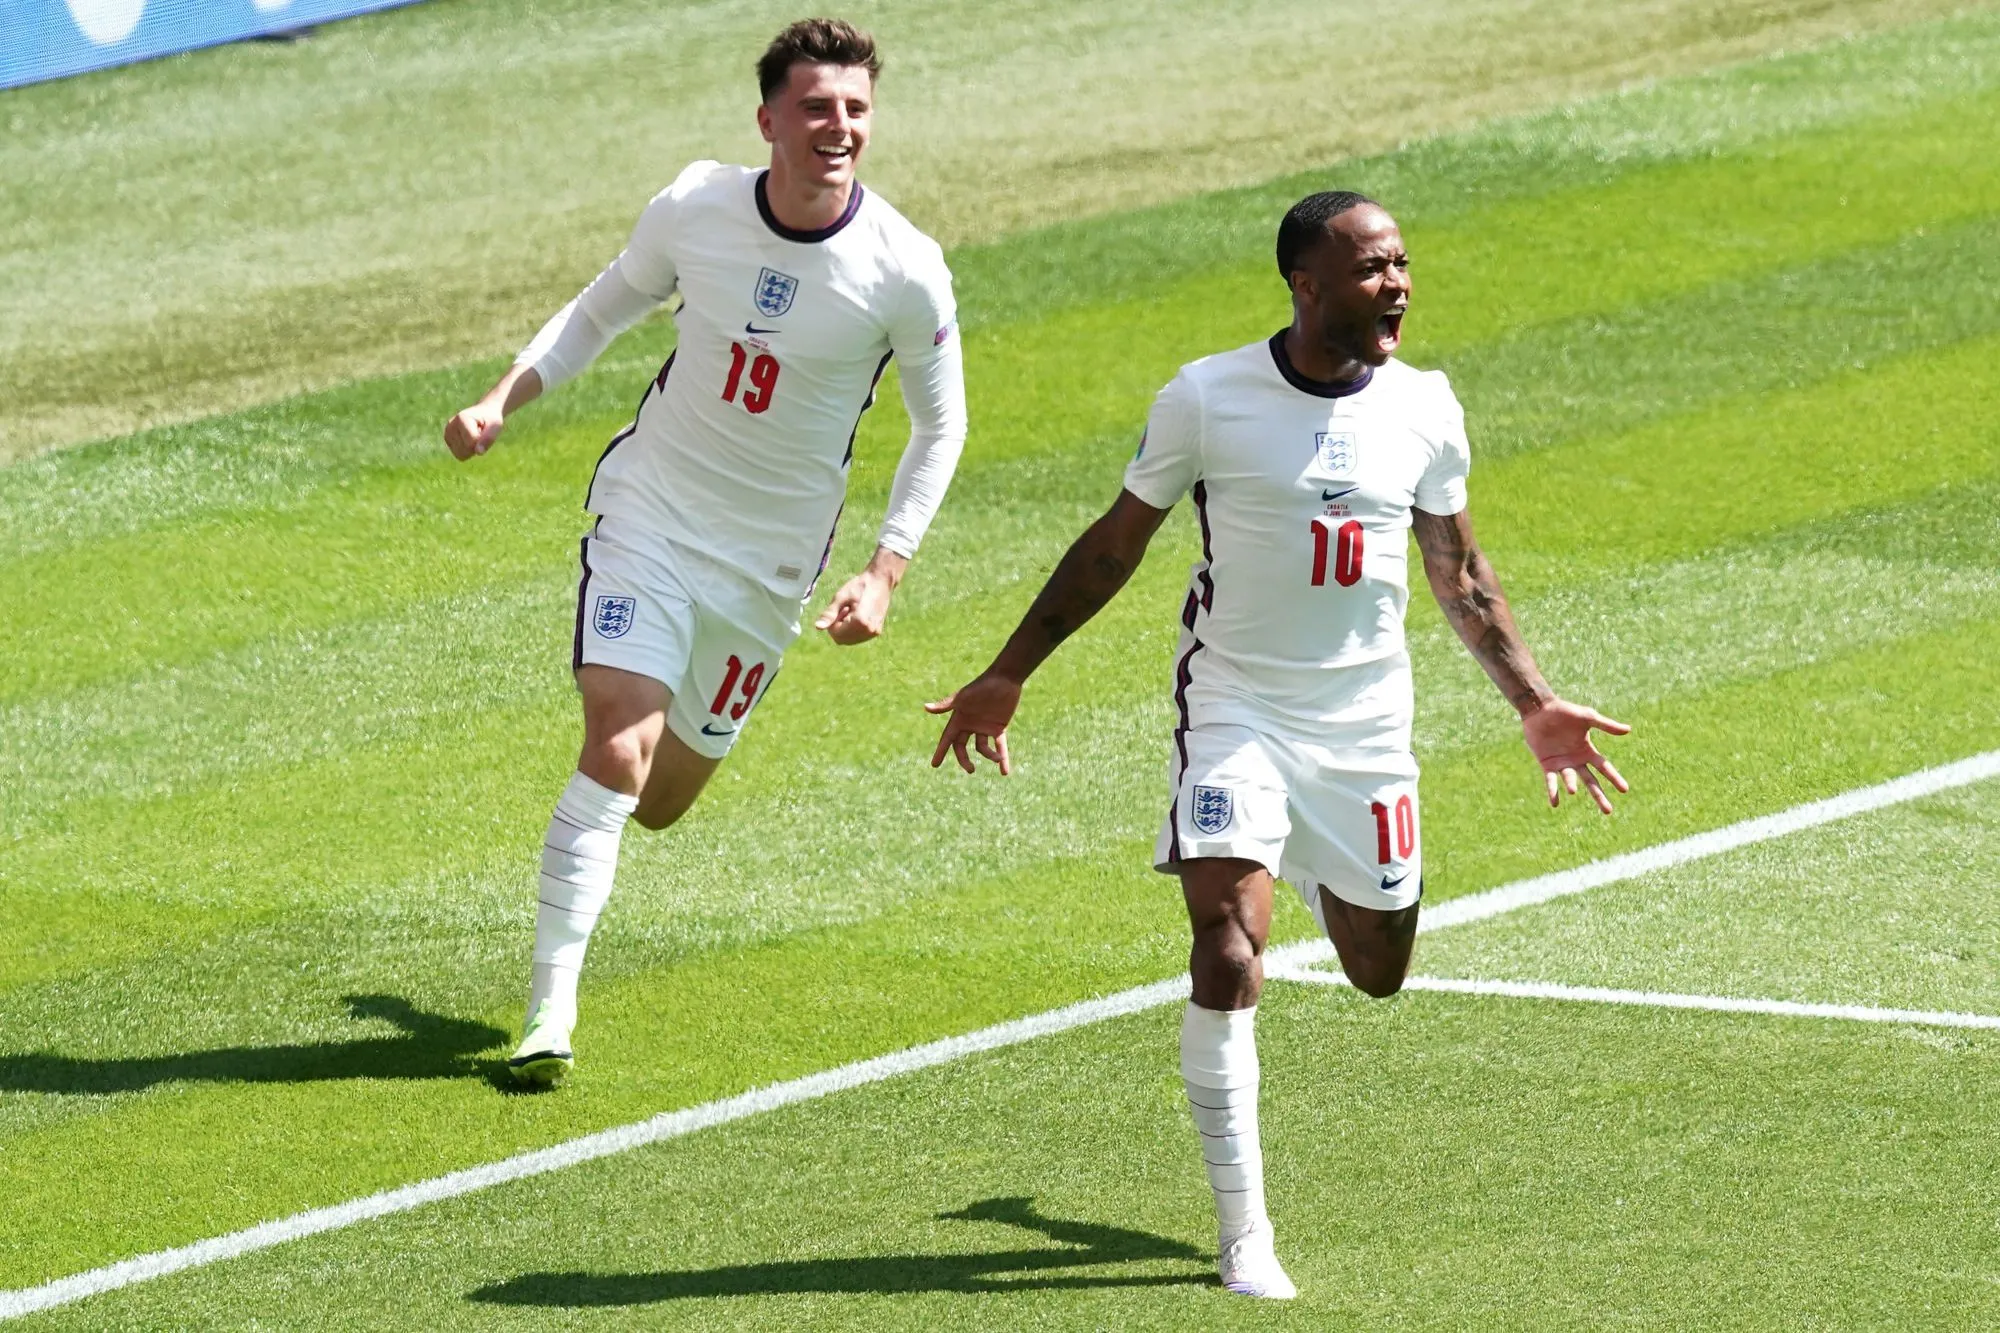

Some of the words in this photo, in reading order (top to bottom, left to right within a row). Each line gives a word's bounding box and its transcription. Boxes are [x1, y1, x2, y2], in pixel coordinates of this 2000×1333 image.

[721, 342, 780, 414] 19
[1311, 519, 1364, 587] 10
[709, 654, 765, 721] 19
[1371, 794, 1414, 865] 10
